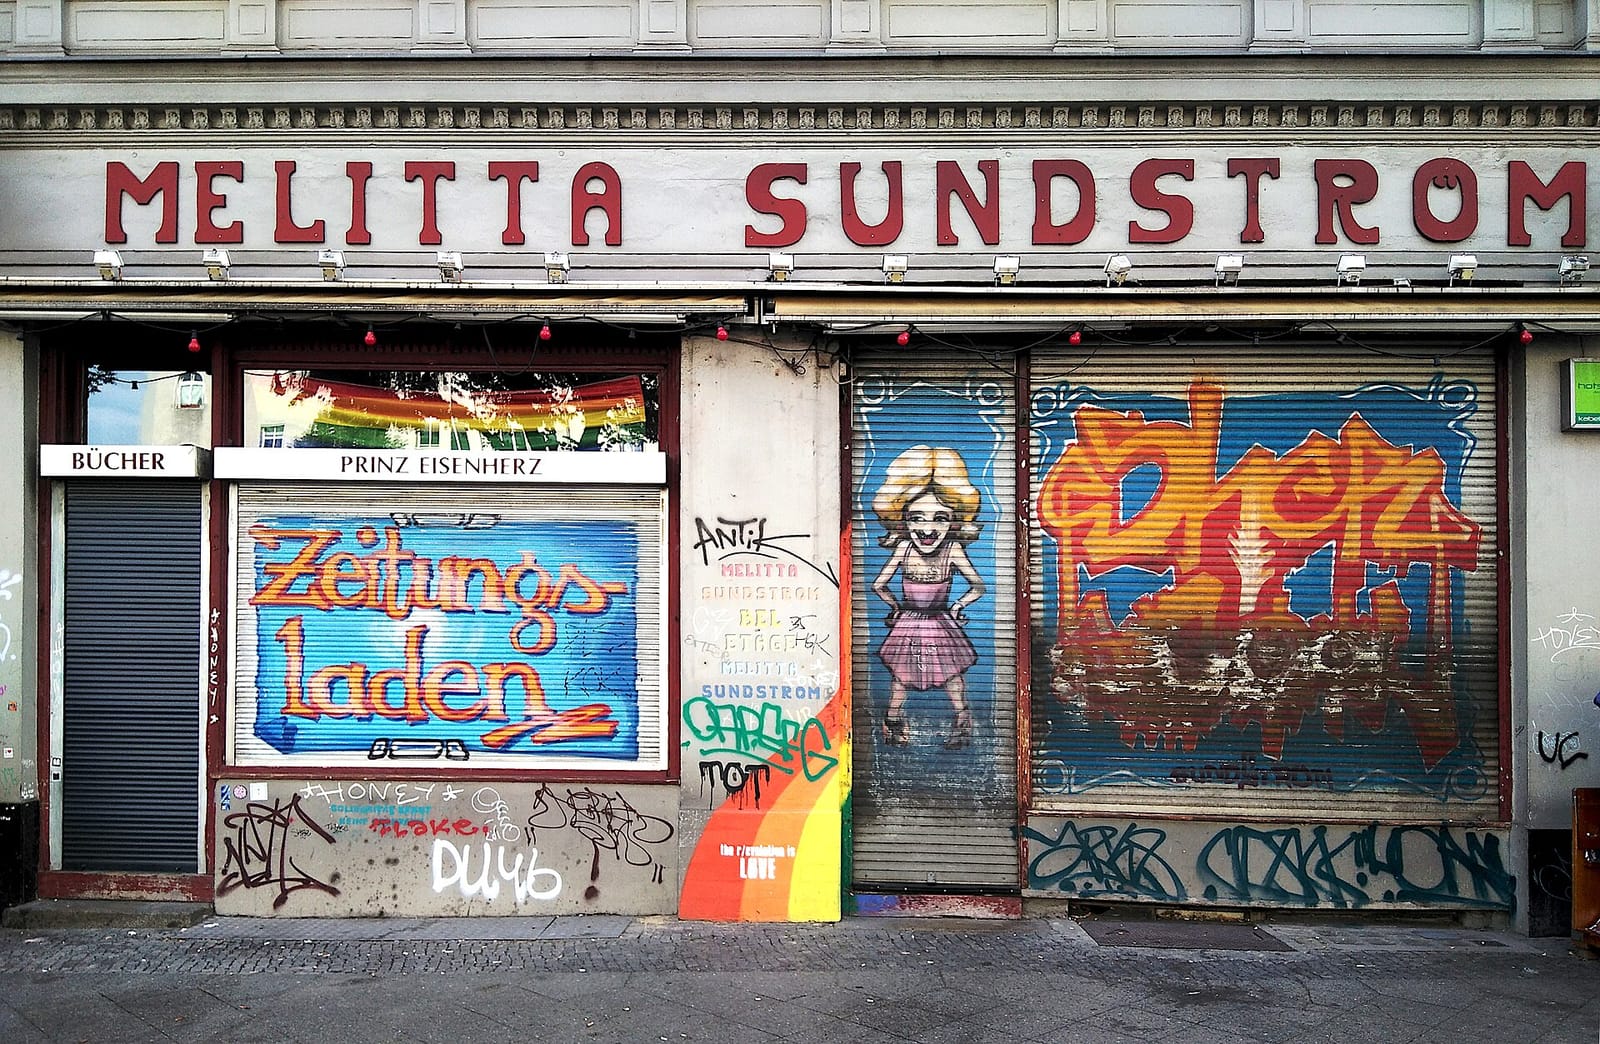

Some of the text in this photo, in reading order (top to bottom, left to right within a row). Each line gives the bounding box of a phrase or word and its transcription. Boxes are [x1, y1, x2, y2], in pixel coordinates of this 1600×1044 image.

[105, 160, 622, 246] MELITTA
[72, 448, 165, 470] BÜCHER
[341, 456, 543, 475] PRINZ EISENHERZ
[720, 563, 799, 578] MELITTA
[738, 608, 781, 627] BEL
[276, 614, 556, 726] laden
[702, 684, 821, 700] SUNDSTROM
[316, 783, 436, 804] HONEY
[739, 857, 776, 880] LOVE
